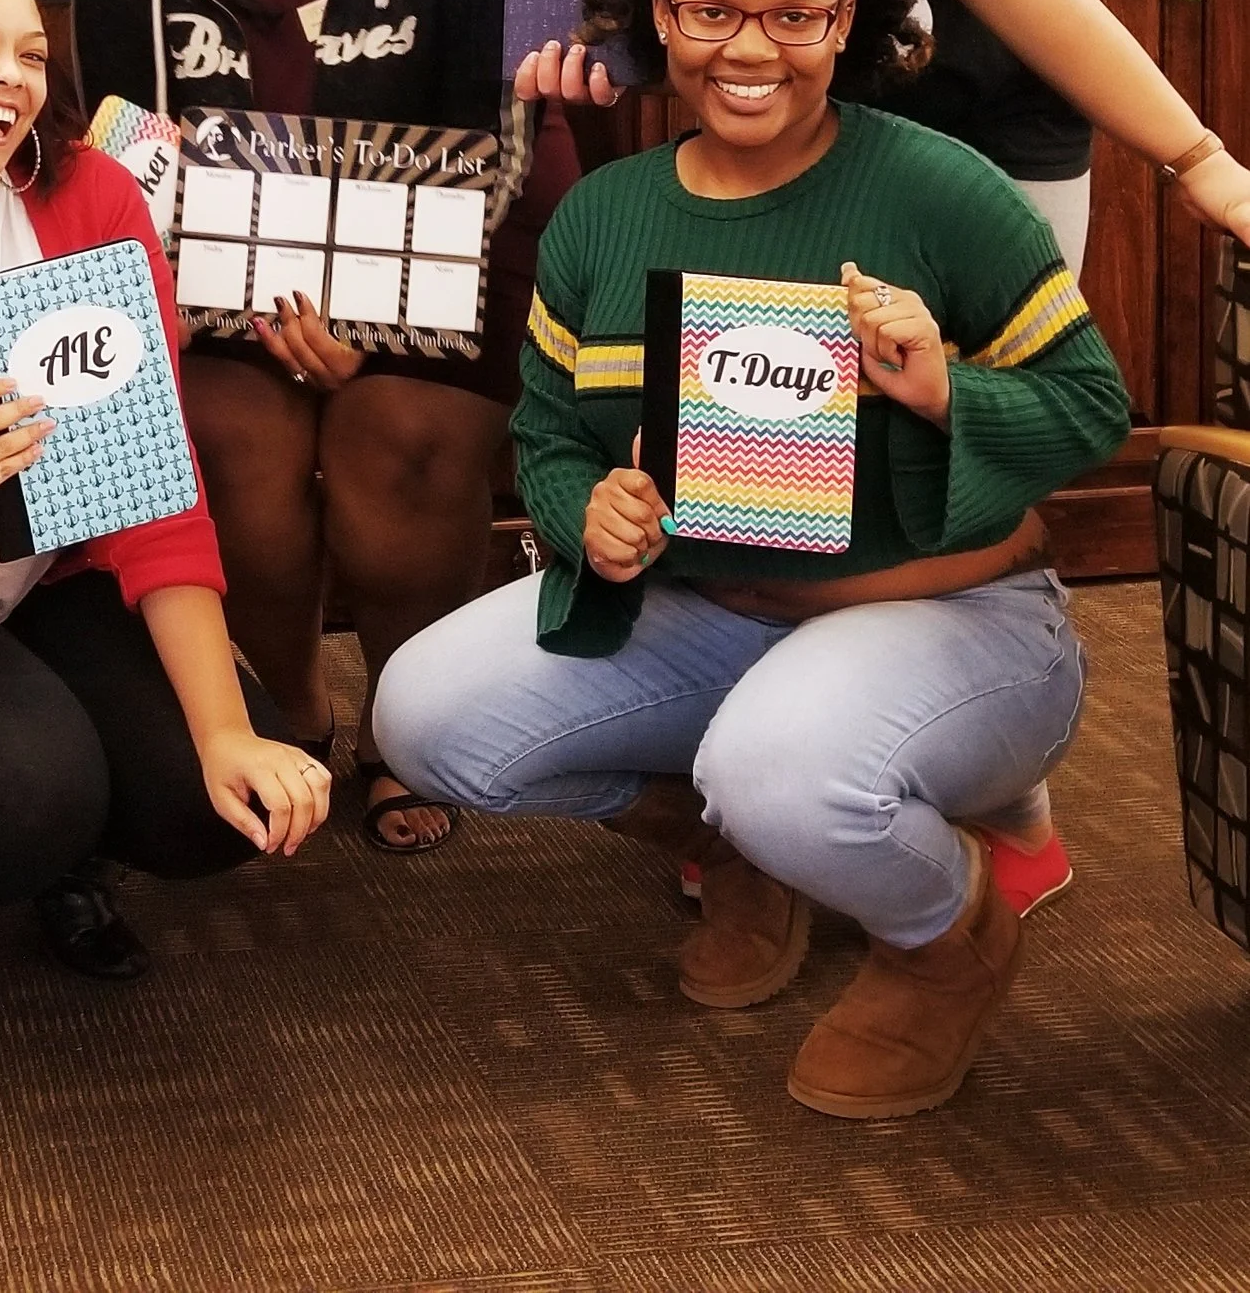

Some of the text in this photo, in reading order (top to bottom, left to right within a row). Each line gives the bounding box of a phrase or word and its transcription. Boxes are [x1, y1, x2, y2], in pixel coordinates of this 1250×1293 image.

[135, 146, 170, 197] ker
[250, 130, 486, 177] Parker's To-Do List
[39, 326, 117, 386] ALE
[707, 349, 835, 400] T.Daye
